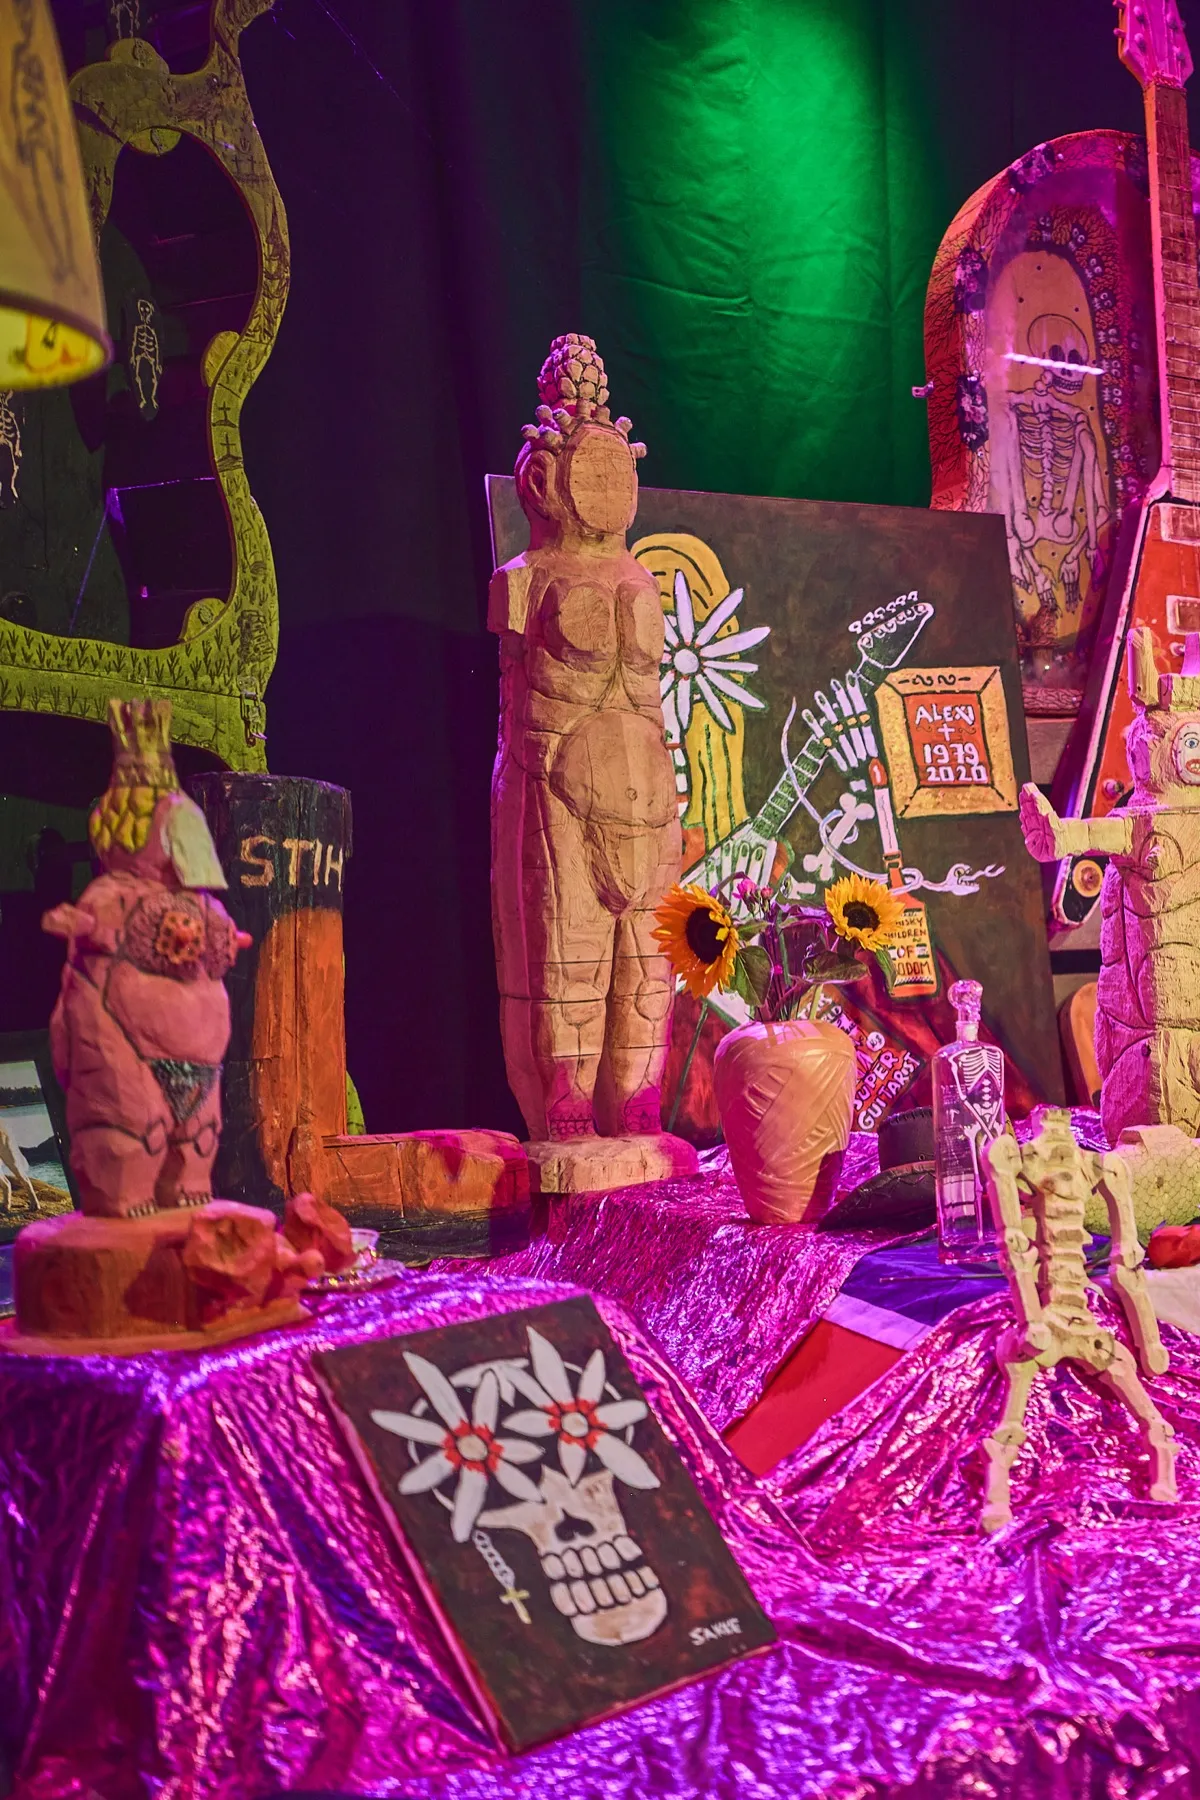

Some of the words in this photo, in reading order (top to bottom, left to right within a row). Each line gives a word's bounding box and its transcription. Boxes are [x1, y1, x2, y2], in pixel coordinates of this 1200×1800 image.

[923, 743, 980, 767] 1979
[926, 765, 987, 783] 2020
[240, 834, 343, 892] STIH
[897, 945, 915, 959] OF
[895, 961, 931, 976] ODOM
[853, 1050, 899, 1111] SUPER
[858, 1051, 921, 1130] GUITARIST
